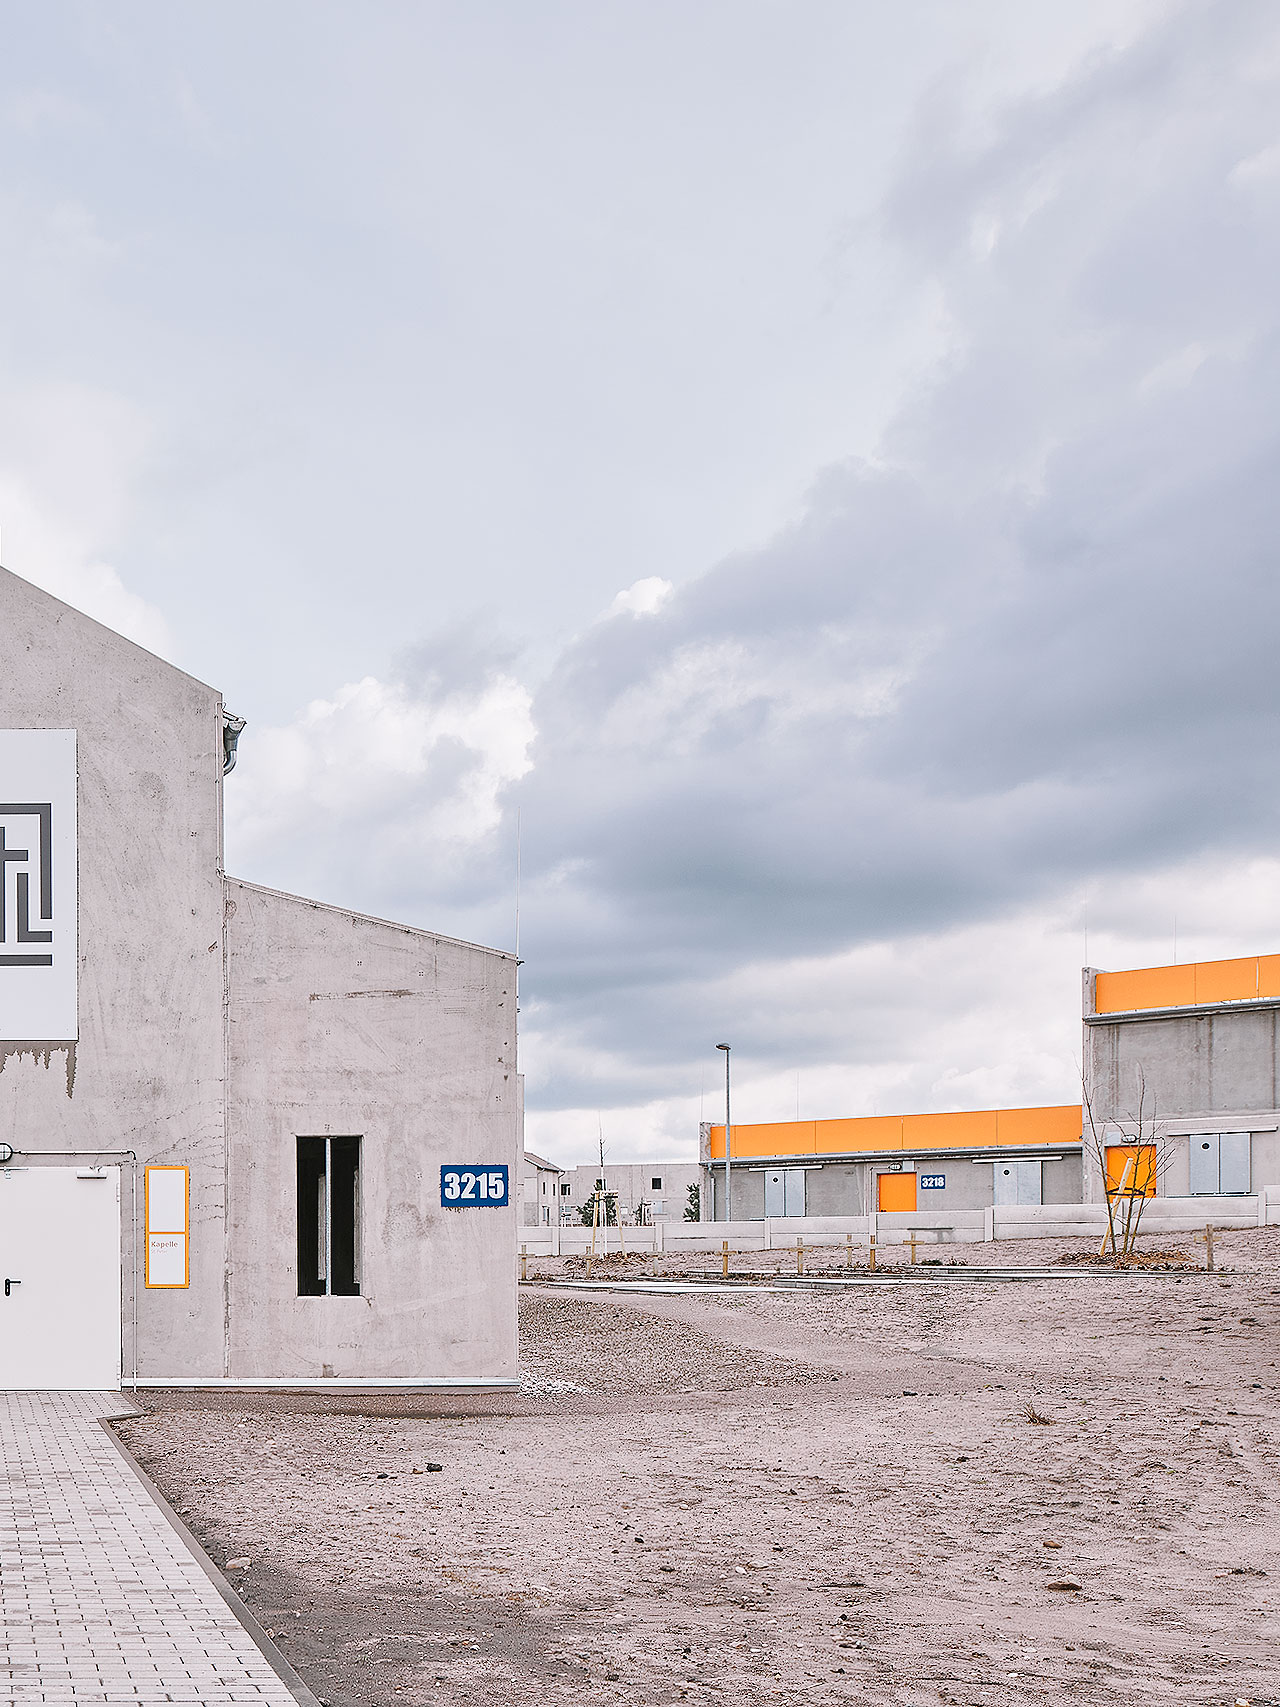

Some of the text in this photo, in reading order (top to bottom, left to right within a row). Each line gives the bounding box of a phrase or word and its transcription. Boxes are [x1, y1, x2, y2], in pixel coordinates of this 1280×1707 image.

[444, 1172, 505, 1200] 3215
[922, 1177, 944, 1188] 3218
[151, 1241, 178, 1249] Kapelle
